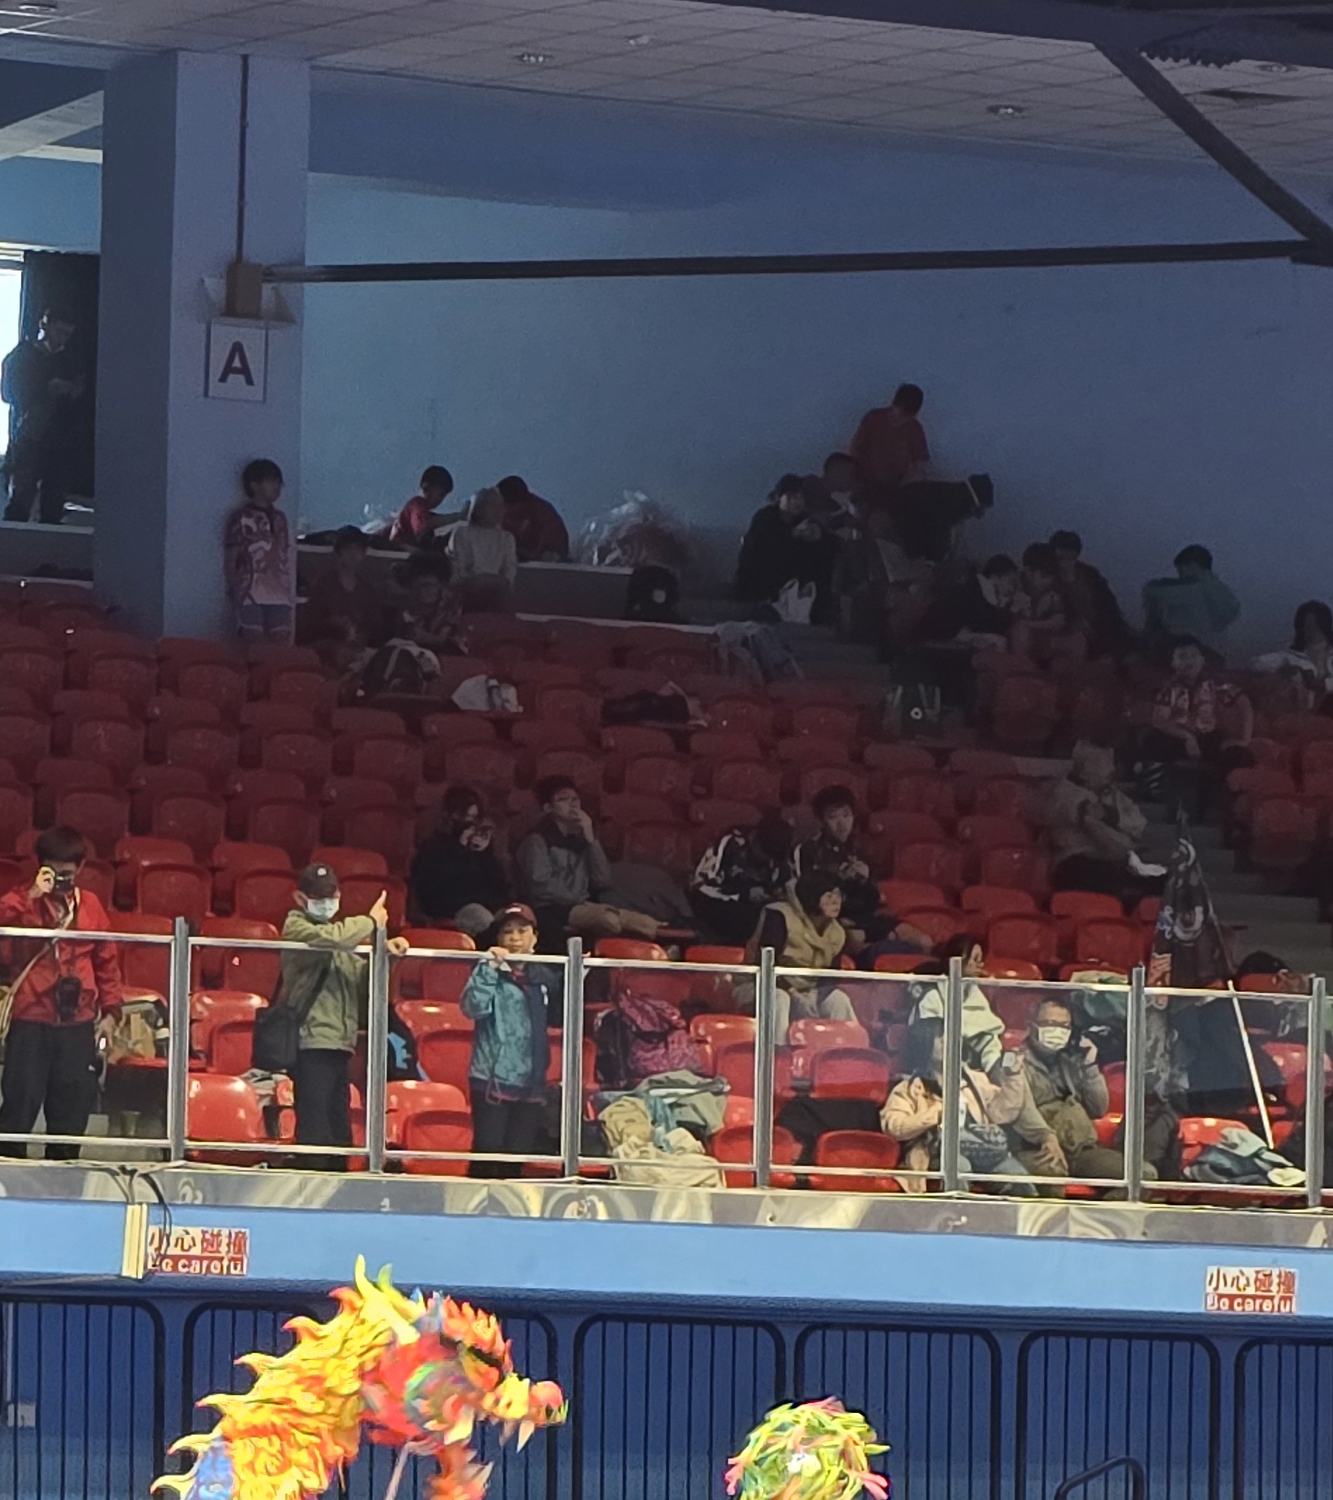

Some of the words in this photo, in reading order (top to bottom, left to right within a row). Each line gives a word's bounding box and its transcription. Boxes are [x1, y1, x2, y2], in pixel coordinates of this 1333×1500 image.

[218, 340, 255, 387] A
[177, 1257, 247, 1275] careful
[1208, 1267, 1296, 1294] 小心碰撞
[1206, 1293, 1230, 1311] Be
[1233, 1295, 1296, 1313] careful
